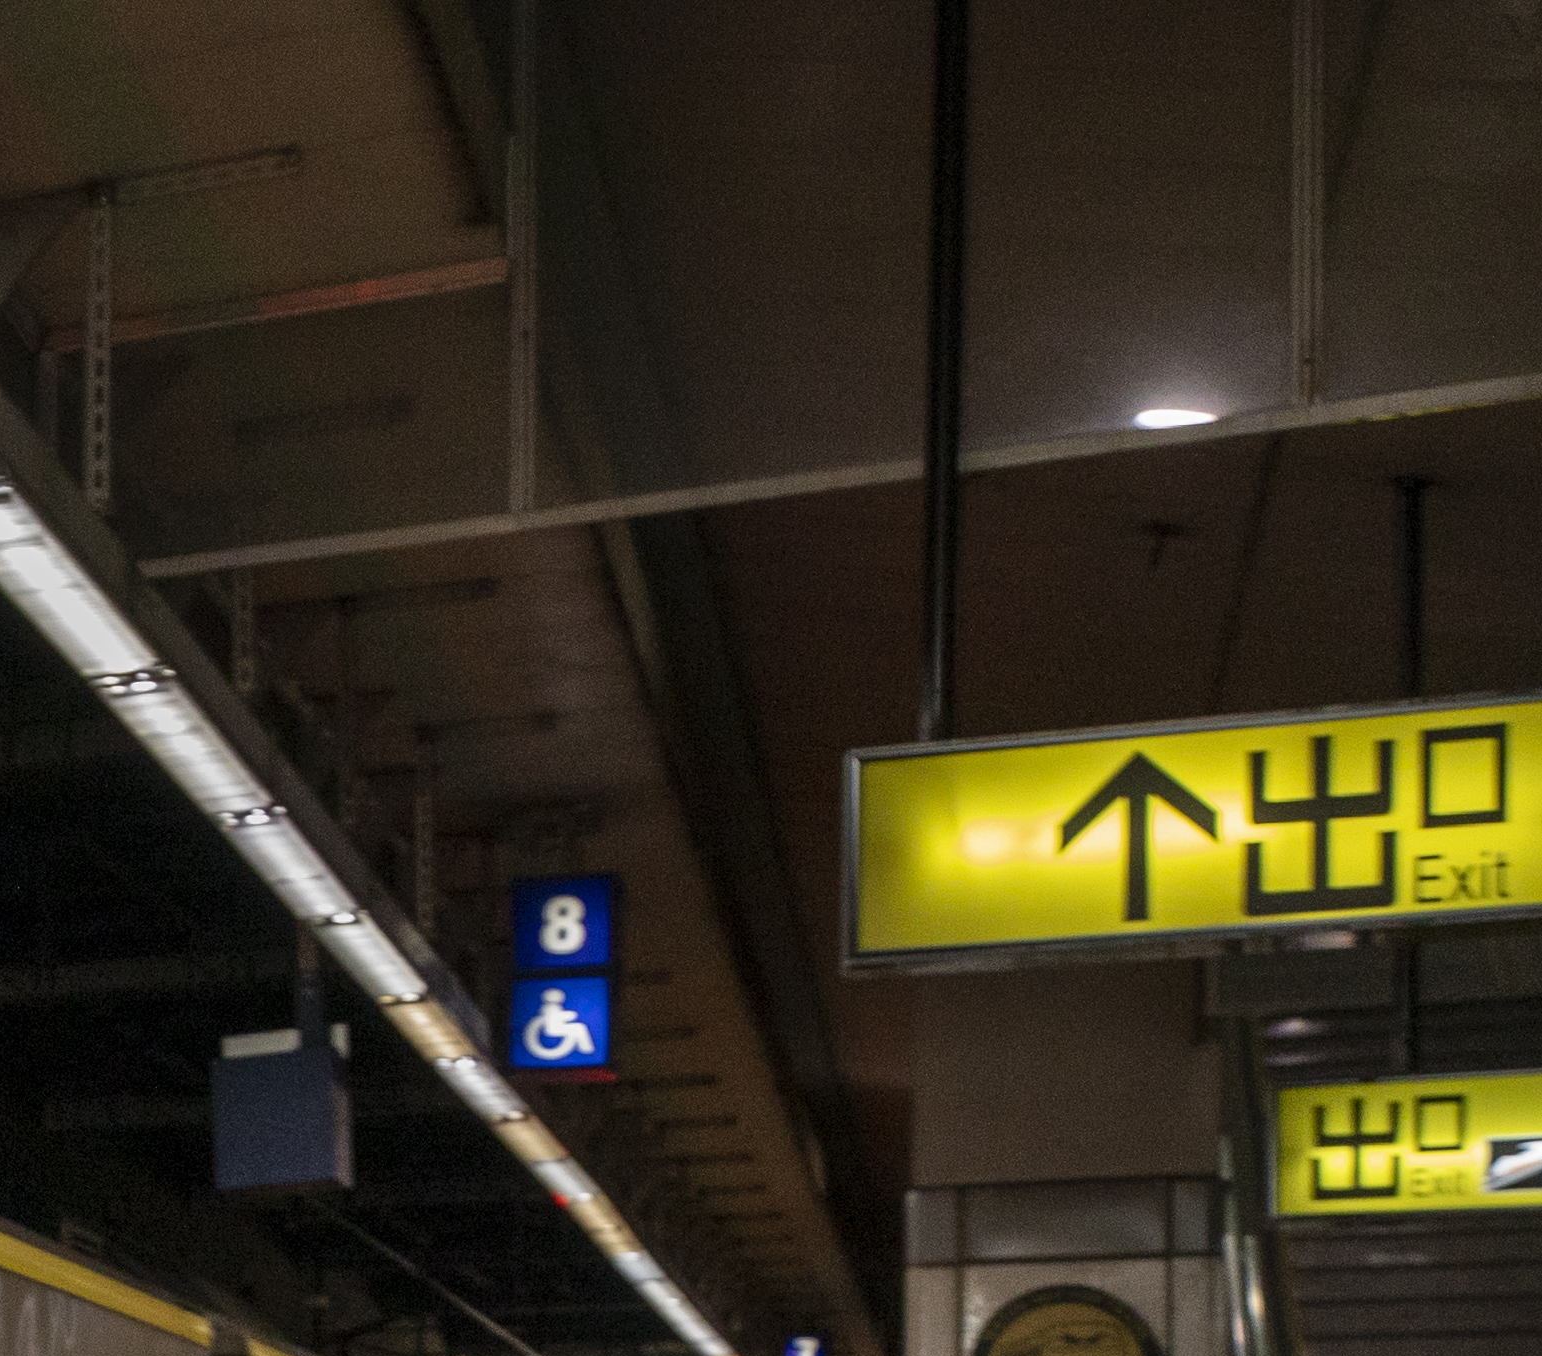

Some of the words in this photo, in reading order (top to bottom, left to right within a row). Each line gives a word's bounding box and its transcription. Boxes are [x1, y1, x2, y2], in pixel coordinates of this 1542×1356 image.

[1245, 721, 1510, 917] 出口
[1414, 850, 1511, 904] Exit
[538, 894, 587, 955] 8
[1311, 1094, 1466, 1201] 出口
